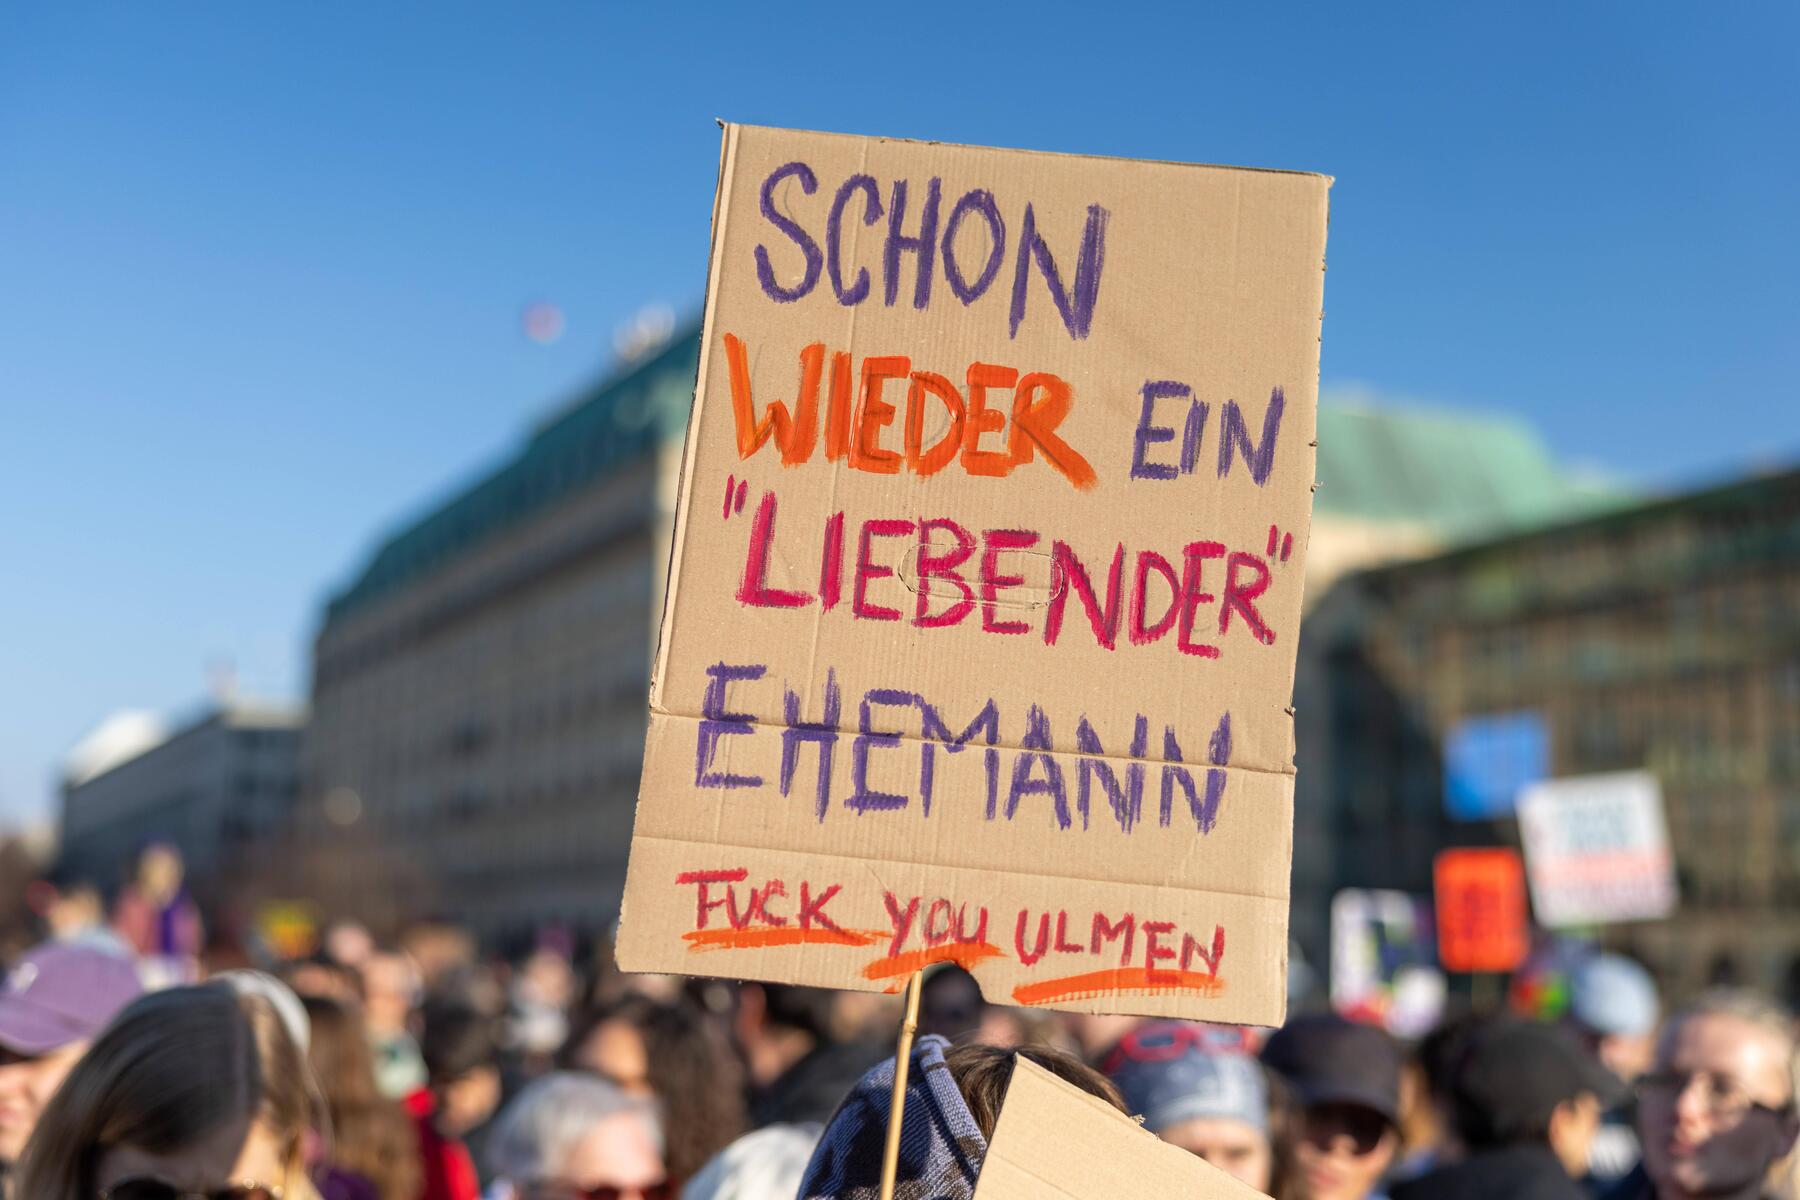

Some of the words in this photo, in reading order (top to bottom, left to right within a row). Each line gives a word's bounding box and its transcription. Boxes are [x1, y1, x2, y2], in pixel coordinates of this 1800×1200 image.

[754, 161, 1110, 340] SCHON
[724, 332, 1099, 491] WIEDER
[1131, 378, 1285, 487] EIN
[723, 474, 1293, 660] "LIEBENDER"
[695, 660, 1232, 835] EHEMANN
[676, 867, 861, 944] FUCK
[882, 891, 988, 959] YOU
[1013, 906, 1226, 983] ULMEN
